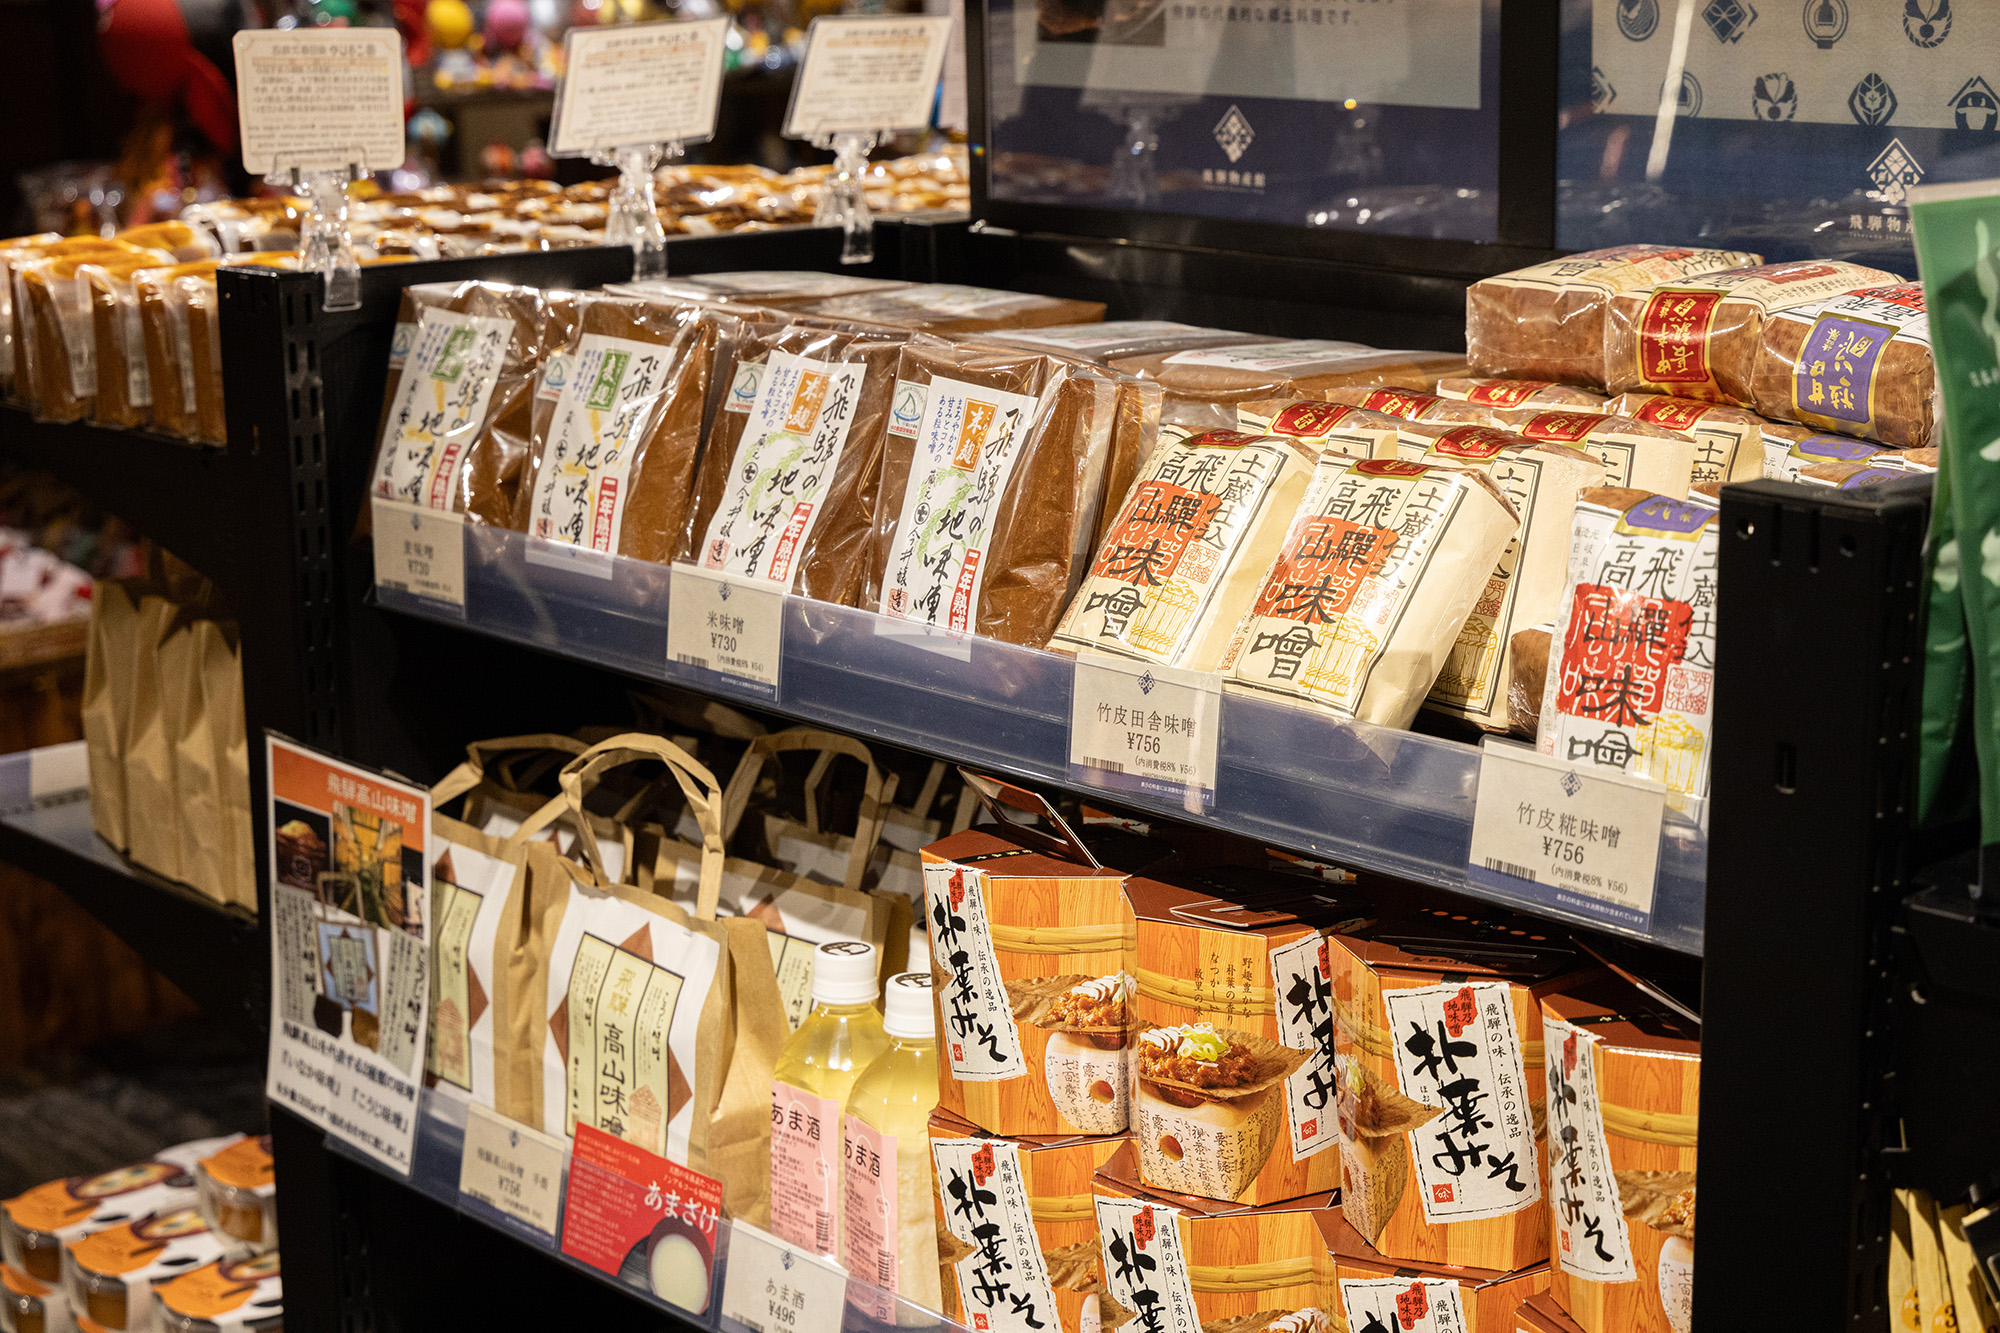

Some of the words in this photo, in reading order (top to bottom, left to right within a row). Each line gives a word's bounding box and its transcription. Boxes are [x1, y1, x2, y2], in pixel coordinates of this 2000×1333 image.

[1808, 360, 1826, 405] 甘口
[928, 394, 946, 454] ある粒味噌
[934, 397, 956, 463] 甘みとコクの
[947, 399, 963, 456] まろやかな
[1194, 453, 1267, 551] 土蔵仕込
[706, 610, 744, 635] 米味噌
[711, 632, 737, 652] ¥730
[1097, 702, 1197, 738] 竹皮田舎味噌
[1127, 732, 1161, 754] ¥756
[1135, 755, 1176, 773] (内消費税8%
[1180, 763, 1197, 776] ¥56)
[327, 772, 418, 824] 飛騨高山味噌
[1516, 801, 1621, 848] 竹皮糀味噌
[1543, 836, 1585, 865] ¥756
[1551, 863, 1602, 887] (内消費税8%
[1607, 878, 1628, 895] ¥56)
[967, 885, 998, 1013] 飛騨の味・伝承の逸品
[932, 892, 1008, 1064] 朴葉みそ
[1225, 964, 1236, 1026] 朴葉の香り
[1447, 1002, 1461, 1035] 地味噌
[1460, 989, 1472, 1024] 飛騨乃
[1485, 1003, 1522, 1139] 飛騨の味・伝承の逸品
[771, 1103, 820, 1141] あま酒
[1404, 1019, 1527, 1192] 朴葉みそ
[1580, 1052, 1605, 1203] 飛騨の味・伝承の逸品
[974, 1154, 985, 1186] 地味噌
[982, 1145, 993, 1175] 飛騨乃
[1549, 1053, 1615, 1263] 朴葉みそ
[498, 1174, 522, 1199] ¥756
[1000, 1159, 1036, 1282] 飛騨の味・伝承の逸品
[947, 1167, 1045, 1330] 朴葉みそ
[766, 1277, 805, 1310] あま酒
[1161, 1224, 1188, 1333] 飛騨の味・伝承の
[769, 1299, 796, 1326] ¥496
[1400, 1294, 1413, 1328] 地味噌
[1411, 1284, 1424, 1318] 飛騨乃
